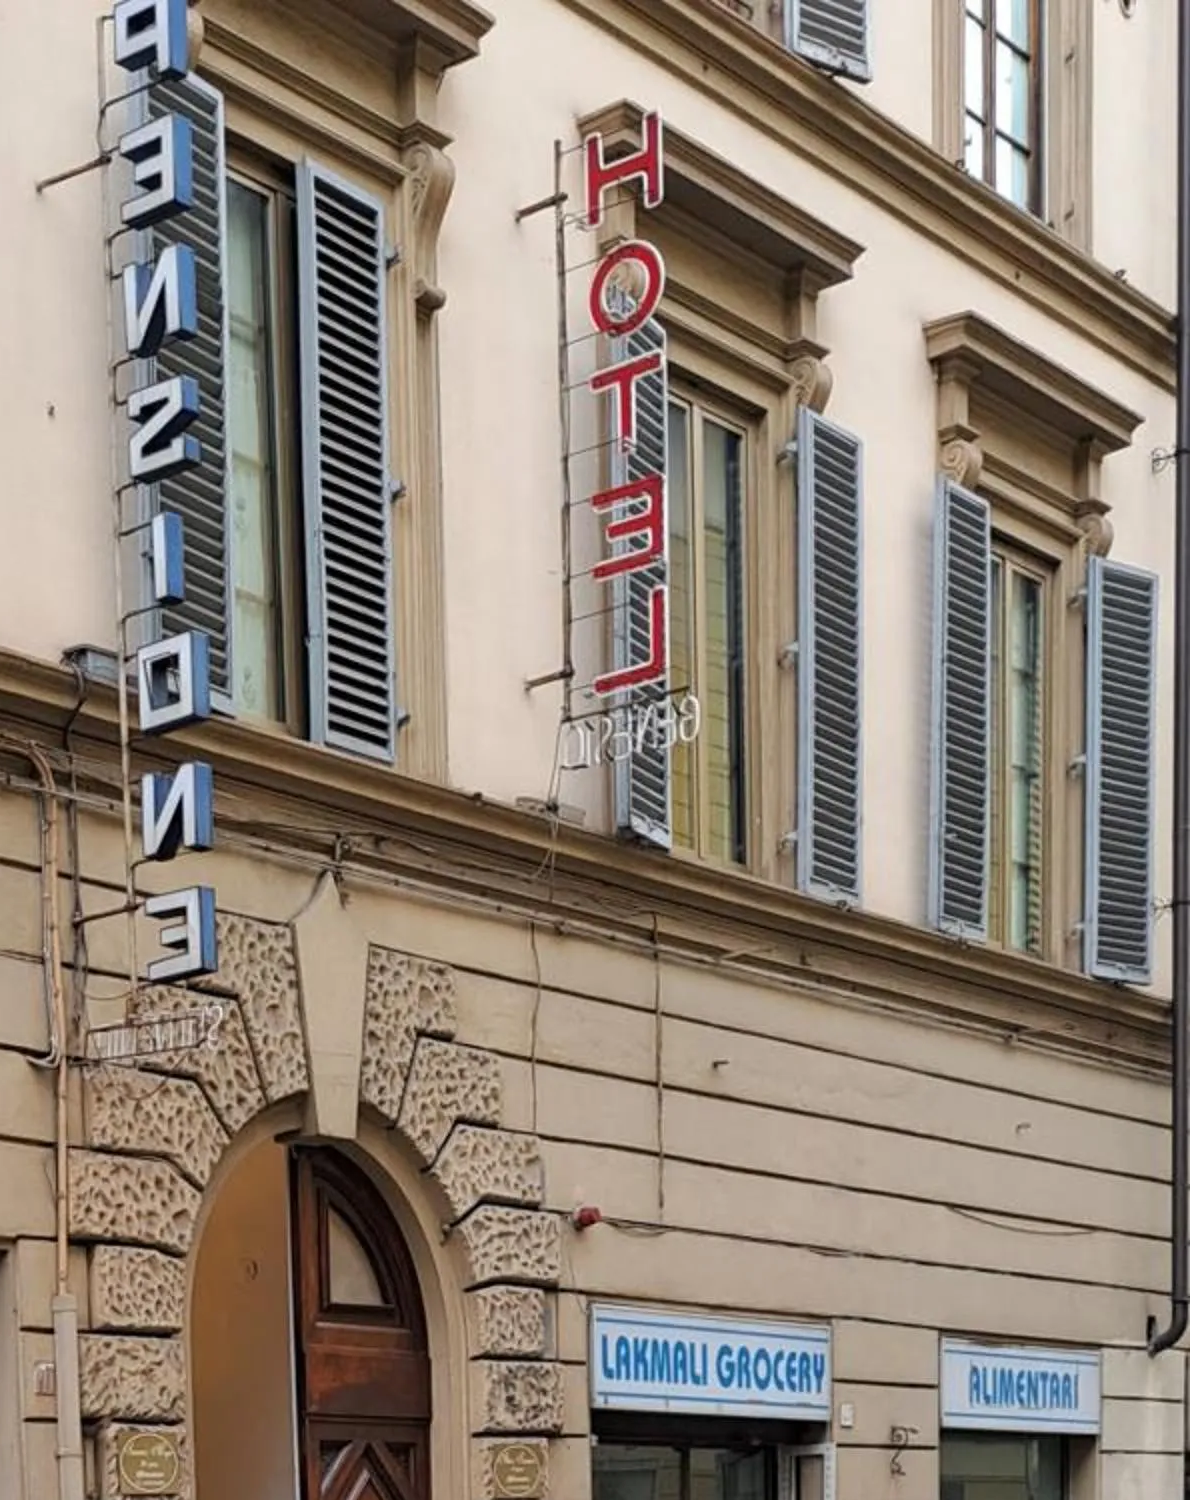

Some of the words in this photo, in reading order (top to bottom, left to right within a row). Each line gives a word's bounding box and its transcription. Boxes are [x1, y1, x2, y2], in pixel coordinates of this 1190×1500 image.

[601, 1334, 708, 1386] LAKMALI
[716, 1344, 826, 1394] GROCERY
[969, 1365, 1080, 1410] ALIMENTARI
